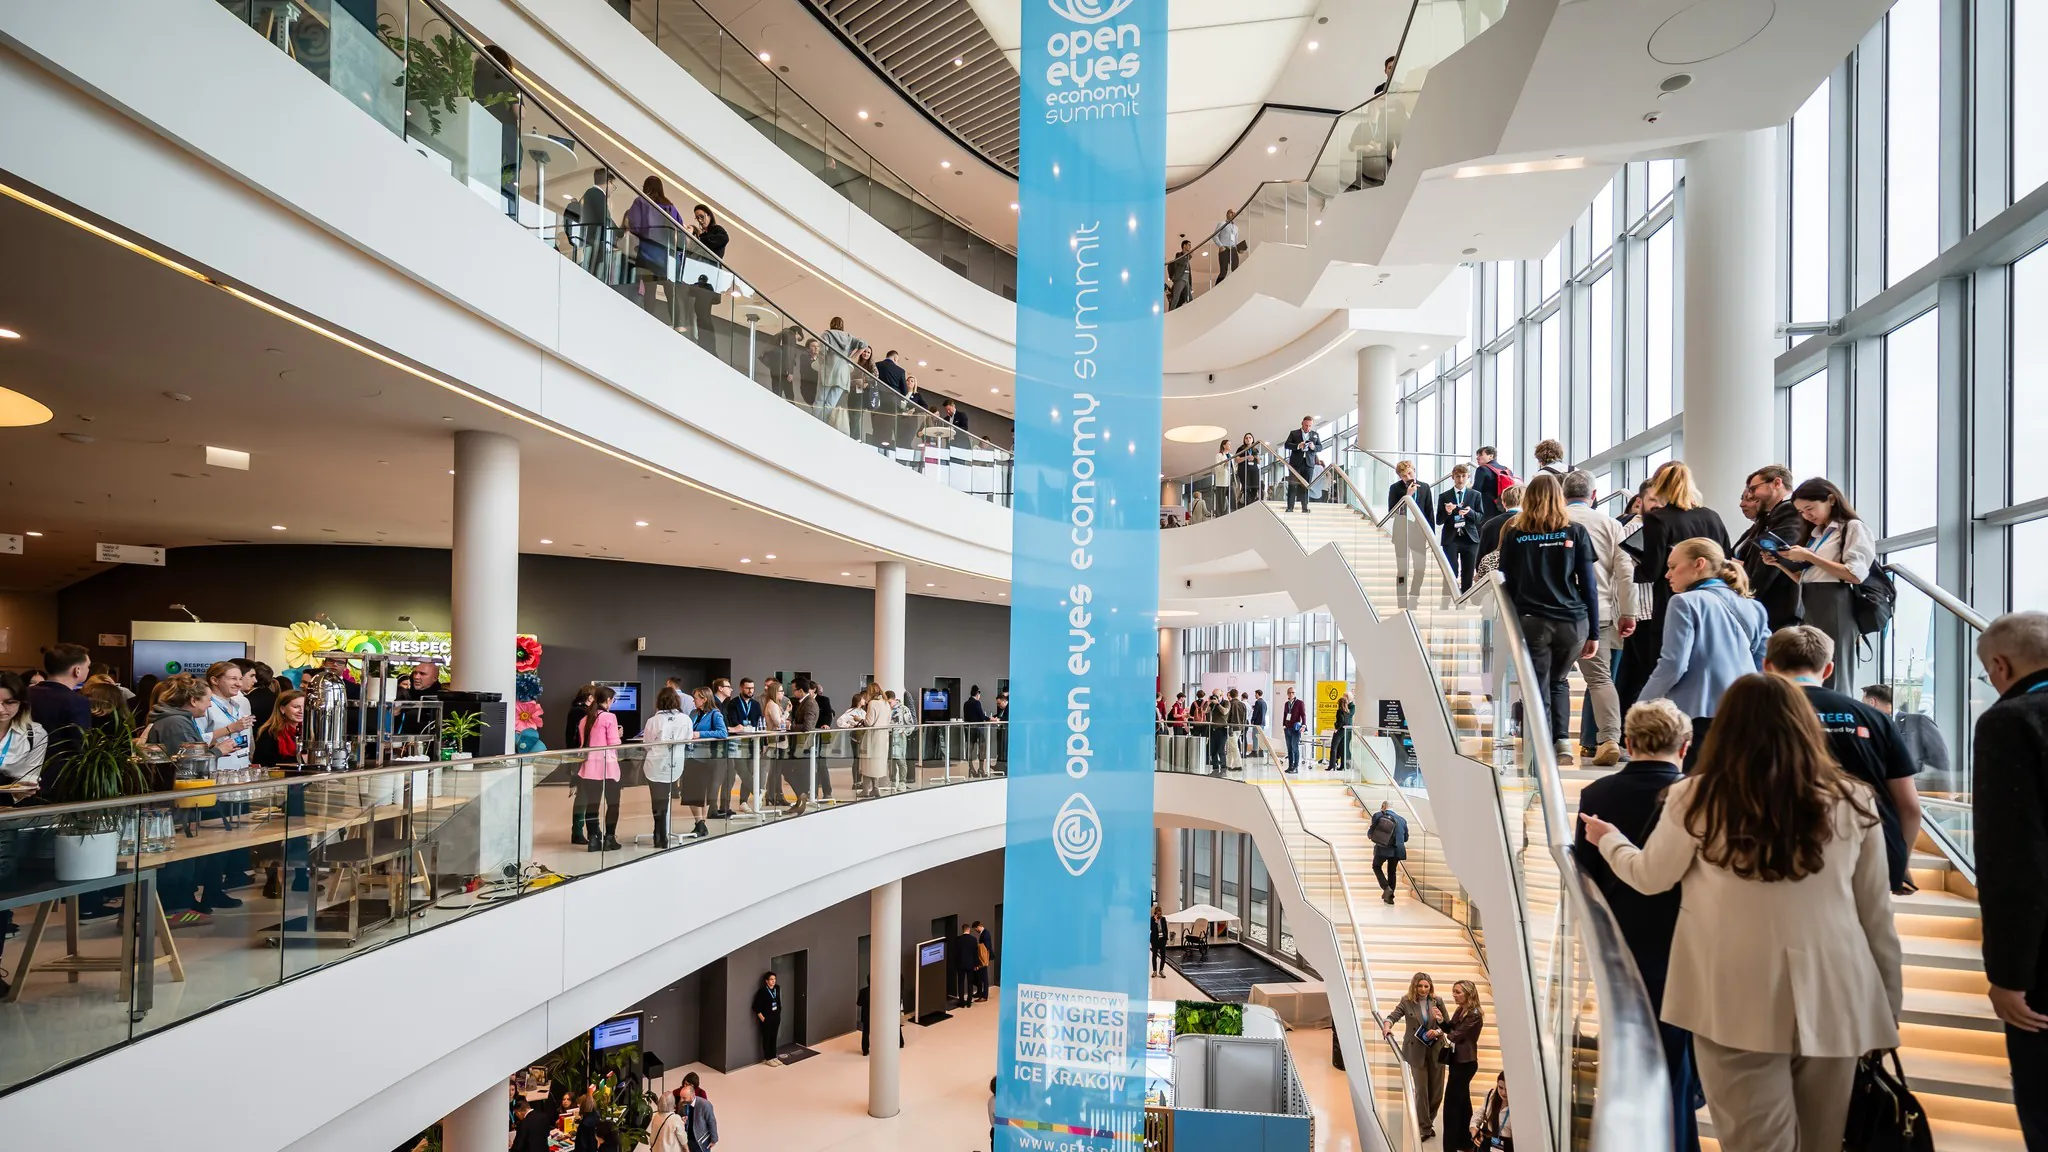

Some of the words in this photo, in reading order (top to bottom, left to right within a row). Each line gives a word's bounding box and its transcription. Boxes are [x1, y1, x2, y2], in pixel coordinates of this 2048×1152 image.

[1047, 23, 1141, 60] open
[1046, 52, 1141, 88] eyes
[1046, 83, 1140, 106] economy
[1045, 100, 1140, 125] summit
[1073, 220, 1101, 380] summit
[1070, 393, 1101, 570] economy
[1516, 531, 1567, 544] VOLUNTEER
[1068, 583, 1096, 676] eyes
[390, 640, 451, 653] RESPEC
[1066, 686, 1094, 779] open
[1020, 989, 1125, 1006] MIĘDZYNARODOWY
[1020, 1001, 1124, 1027] KONGRES
[1020, 1021, 1123, 1047] EKONOMII
[1019, 1040, 1123, 1066] WARTOŚCI
[1014, 1064, 1042, 1083] ICE
[1048, 1067, 1126, 1091] KRAKÓW
